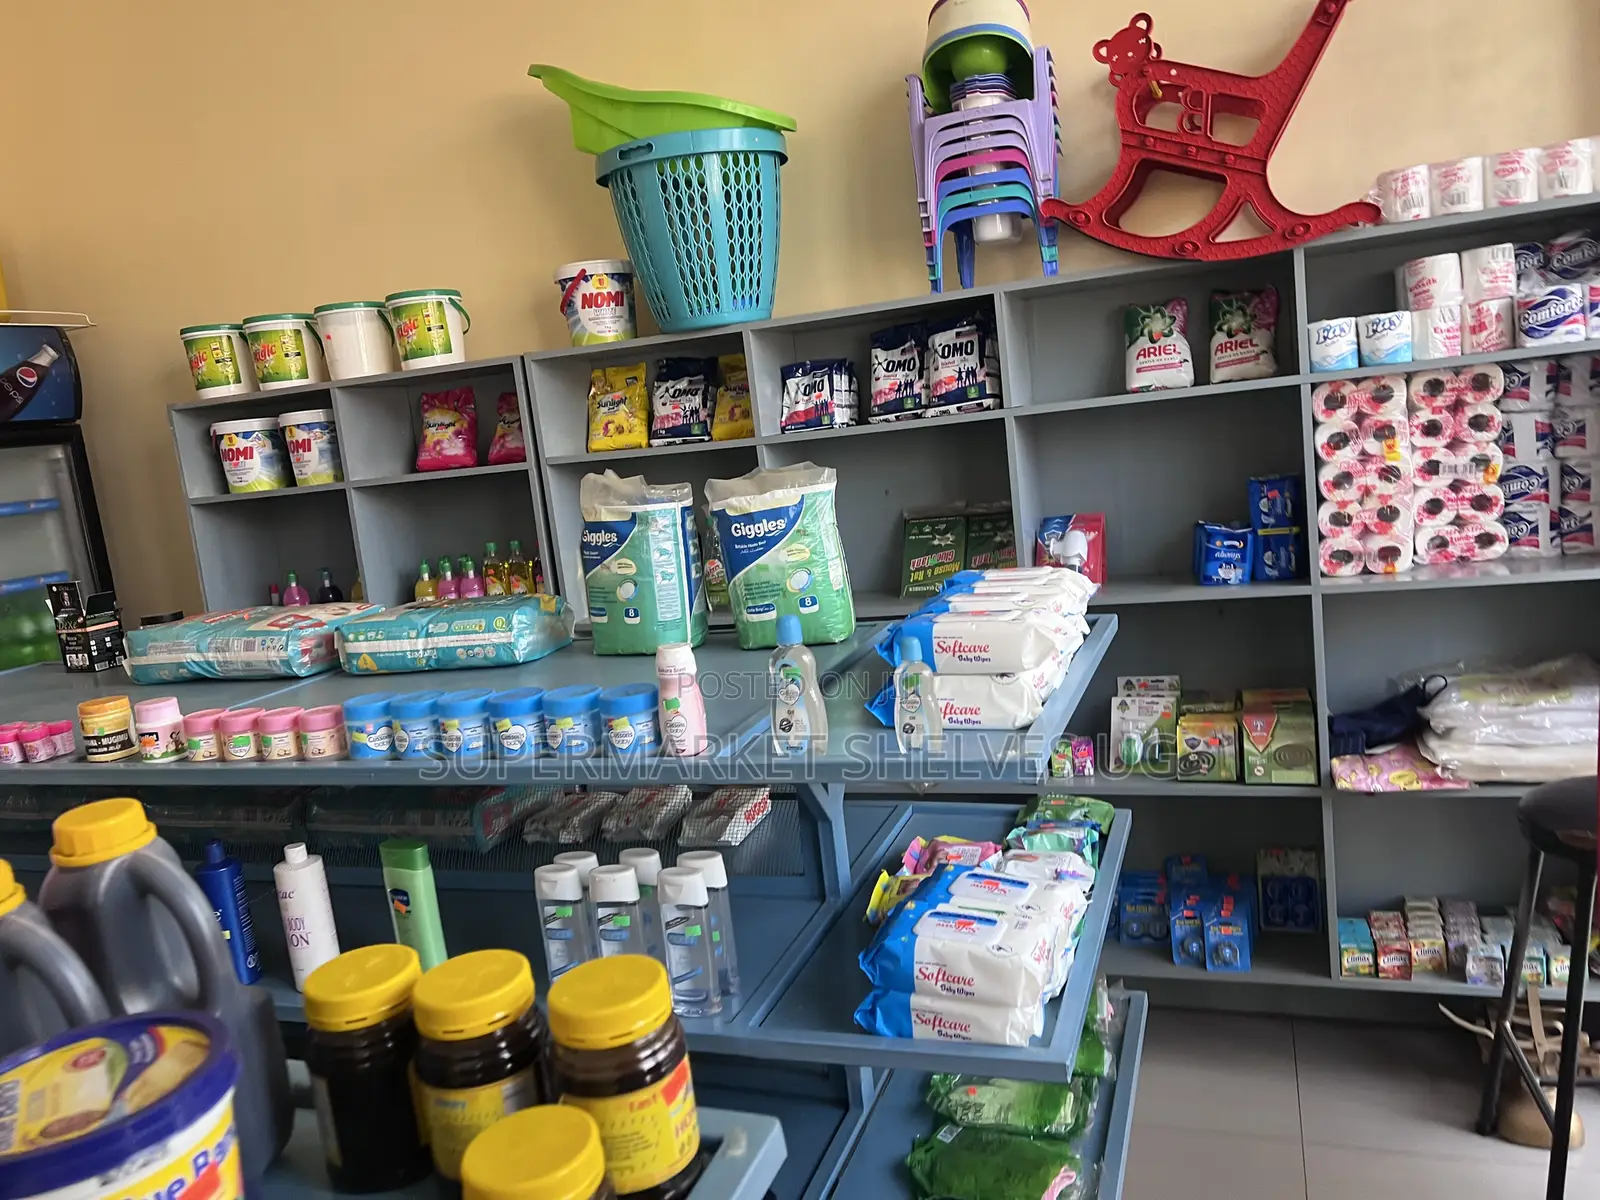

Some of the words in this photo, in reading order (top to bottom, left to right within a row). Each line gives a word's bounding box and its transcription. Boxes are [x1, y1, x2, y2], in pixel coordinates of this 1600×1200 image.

[580, 290, 624, 310] NOMI
[940, 340, 975, 359] OMO
[1136, 343, 1182, 361] ARIEL
[1213, 338, 1259, 357] ARIEL
[885, 358, 917, 373] OMO
[288, 438, 312, 455] OMI
[730, 518, 787, 539] Giggles
[582, 530, 618, 546] Giggles
[804, 597, 813, 606] 8
[628, 608, 635, 617] 8
[935, 640, 990, 657] Softcare
[957, 655, 973, 663] Baby
[939, 701, 981, 720] ftcare
[948, 716, 963, 726] Baby
[915, 966, 975, 987] Softcare
[940, 983, 957, 995] Baby
[957, 987, 975, 997] Wipes
[913, 1012, 971, 1033] Softcare
[937, 1029, 953, 1040] Baby
[953, 1033, 972, 1041] Wipes
